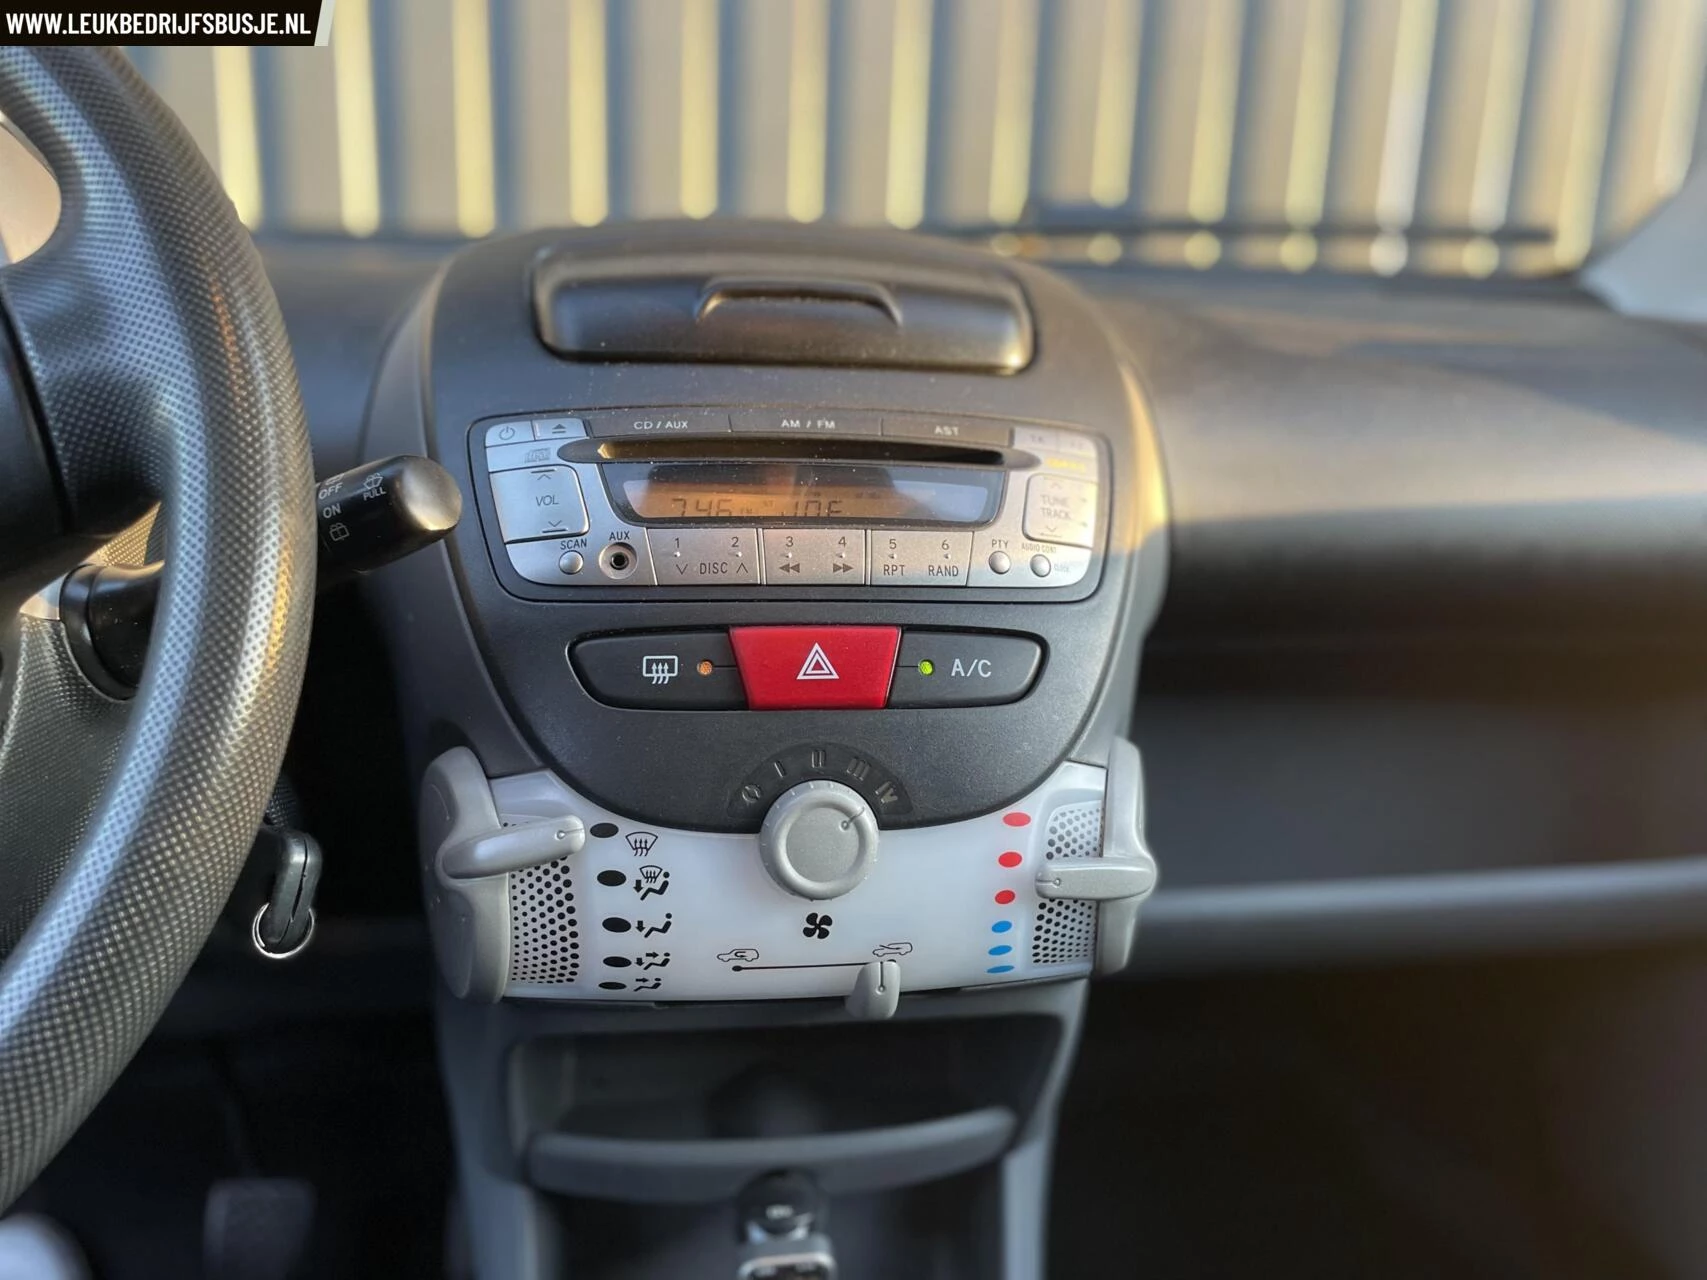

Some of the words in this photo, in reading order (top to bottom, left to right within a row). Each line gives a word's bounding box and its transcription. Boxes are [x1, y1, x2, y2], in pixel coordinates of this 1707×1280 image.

[633, 420, 653, 430] CD
[665, 420, 689, 430] AUX
[781, 419, 801, 429] AM
[817, 419, 836, 430] FM
[318, 482, 344, 500] OFF
[363, 486, 387, 501] PULL
[535, 494, 560, 507] VOL
[323, 503, 342, 519] ON
[608, 530, 631, 542] AUX
[731, 536, 739, 548] 2
[785, 536, 794, 548] 3
[838, 536, 847, 548] 4
[559, 537, 588, 550] SCAN
[674, 537, 680, 549] 1
[888, 538, 897, 550] 5
[941, 539, 950, 551] 6
[991, 539, 1009, 549] PTY
[699, 562, 728, 575] DISC
[882, 564, 905, 577] RPT
[927, 564, 960, 578] RAND
[950, 658, 993, 679] A/C
